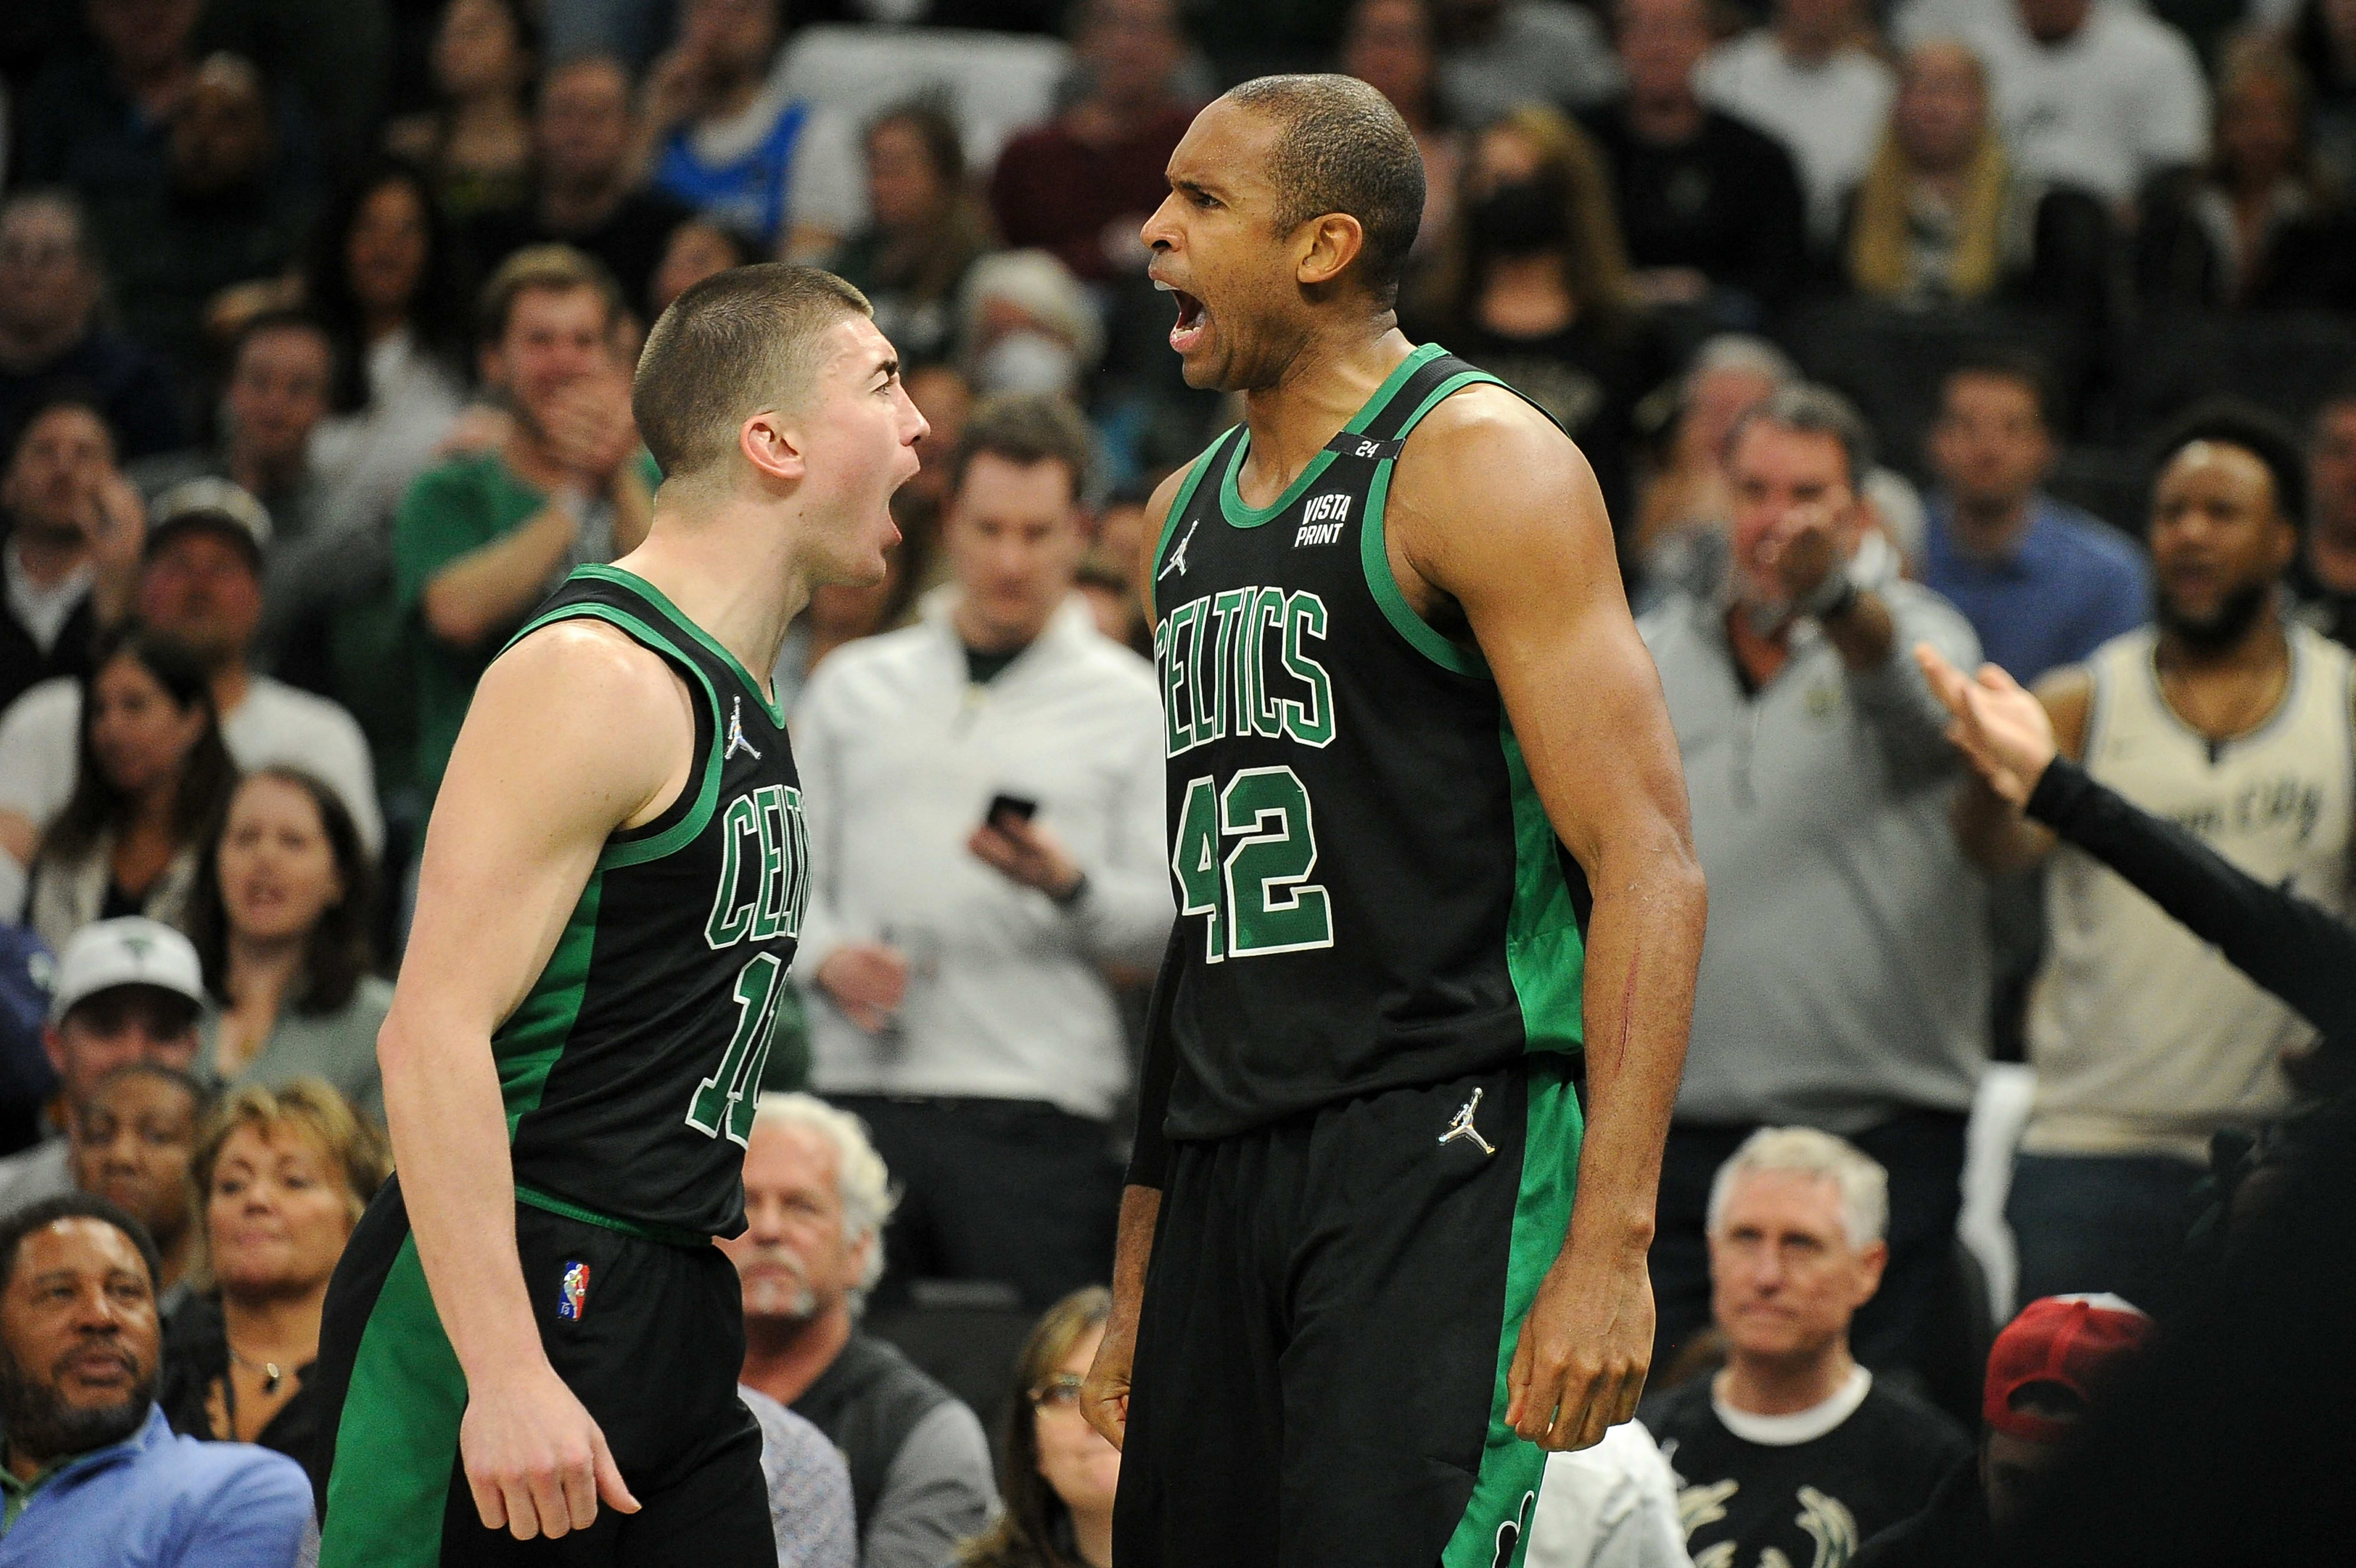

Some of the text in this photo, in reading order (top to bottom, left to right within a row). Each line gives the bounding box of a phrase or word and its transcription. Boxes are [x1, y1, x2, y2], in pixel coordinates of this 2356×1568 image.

[1355, 440, 1381, 458] 24
[1302, 494, 1352, 525] VISTA
[1294, 522, 1344, 547] PRINT
[1172, 765, 1333, 964] 42
